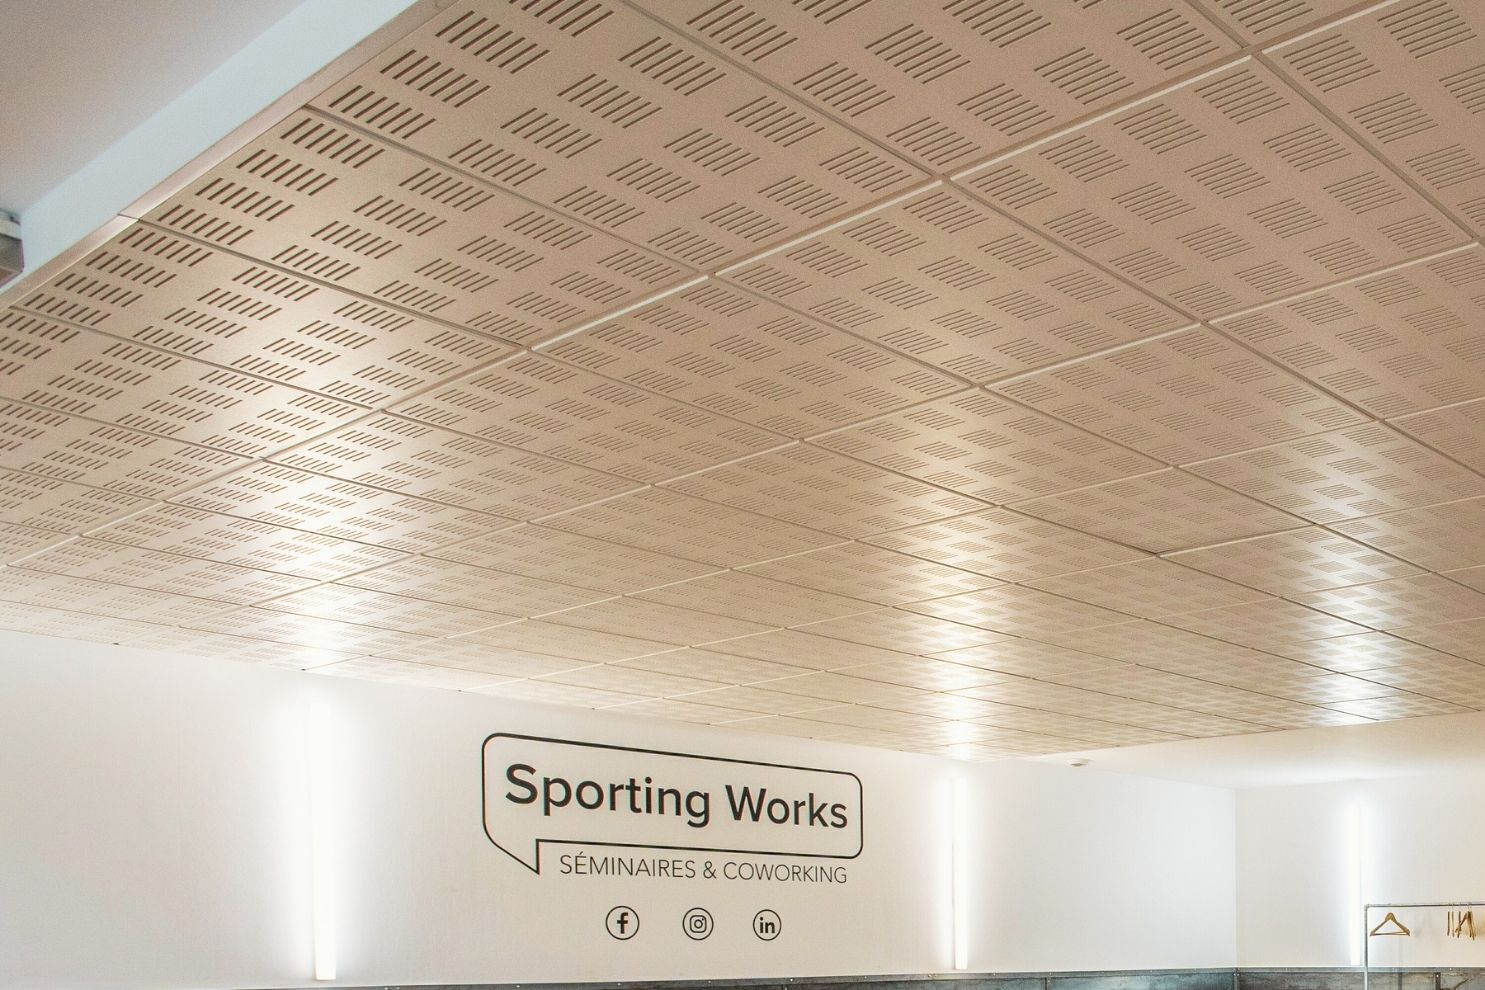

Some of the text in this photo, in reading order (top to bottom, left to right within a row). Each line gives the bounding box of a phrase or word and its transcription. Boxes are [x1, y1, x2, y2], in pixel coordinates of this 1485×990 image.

[505, 763, 848, 830] Sporting Works
[559, 850, 848, 884] SÉMINAIRES & COWORKING
